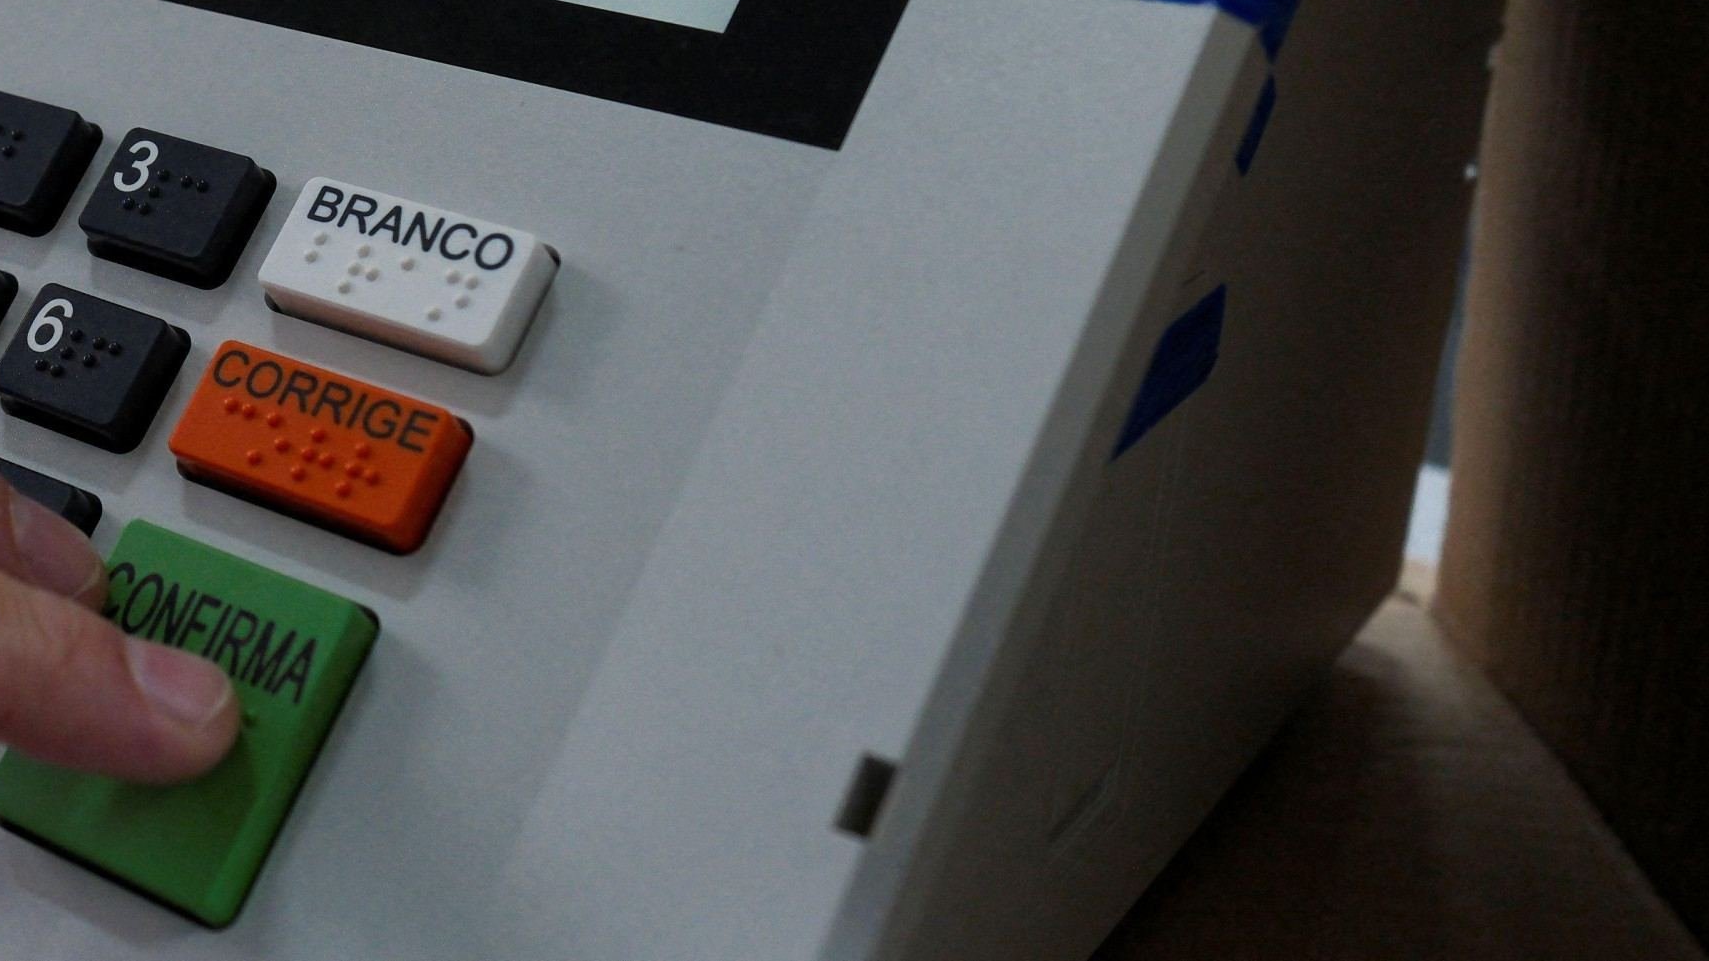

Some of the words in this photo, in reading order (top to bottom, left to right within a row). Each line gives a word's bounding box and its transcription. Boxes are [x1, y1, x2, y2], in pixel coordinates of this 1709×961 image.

[114, 140, 160, 194] 3
[305, 185, 515, 274] BRANCO
[26, 298, 74, 352] 6
[212, 348, 438, 454] CORRIGE
[103, 561, 317, 704] CONFIRMA
